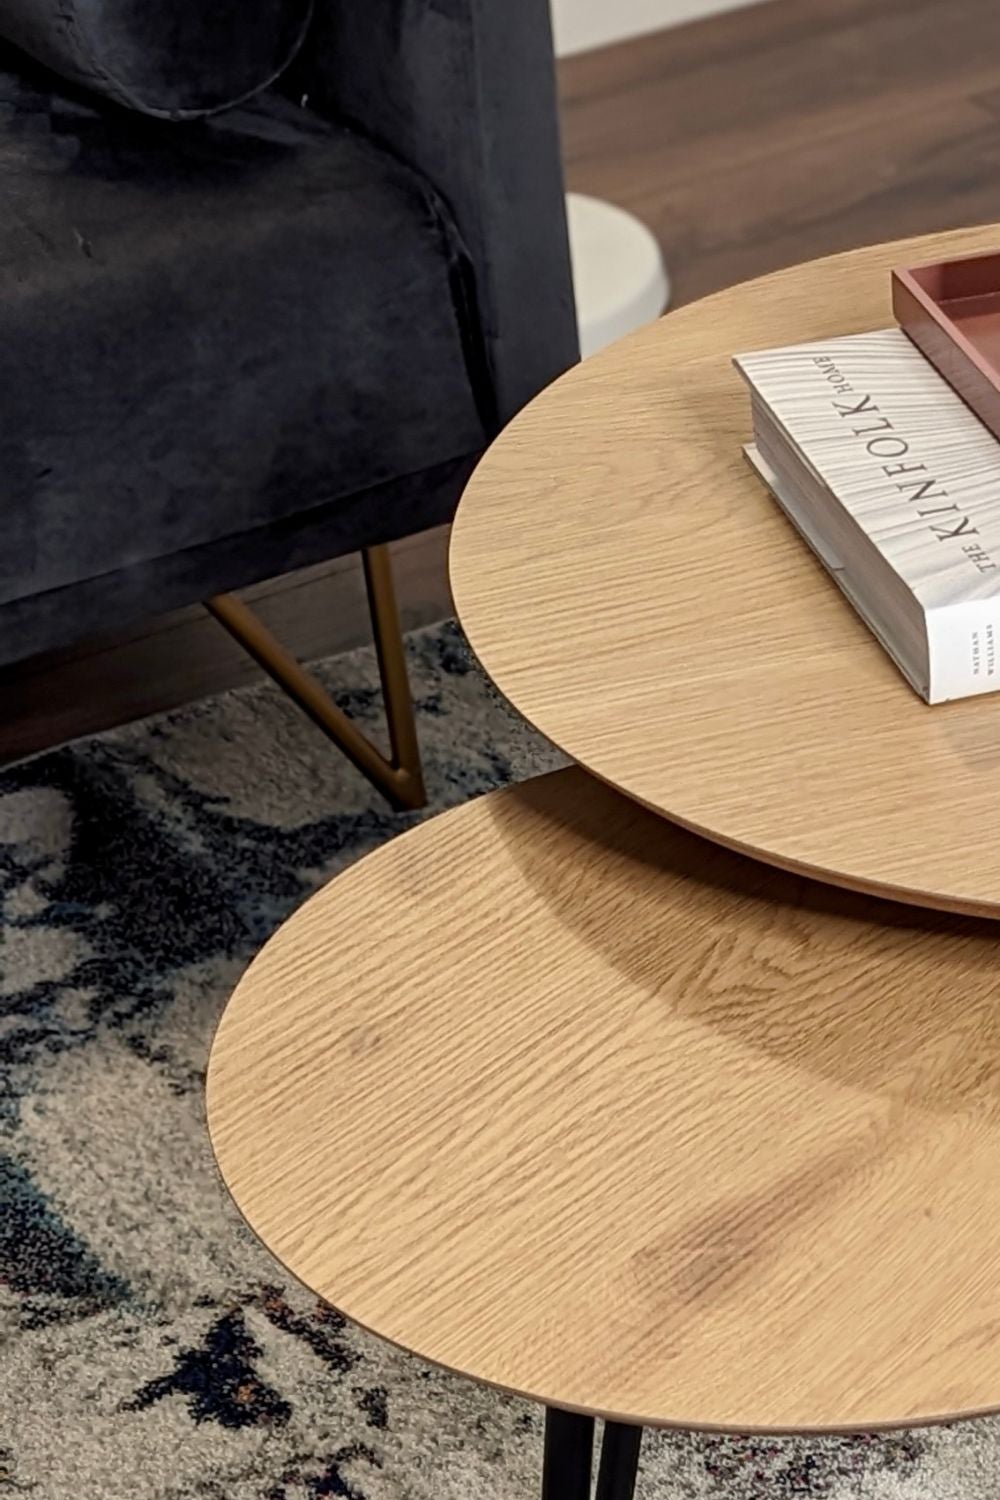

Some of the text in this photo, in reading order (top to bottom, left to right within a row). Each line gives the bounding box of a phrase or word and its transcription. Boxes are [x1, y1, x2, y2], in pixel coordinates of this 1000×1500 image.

[812, 355, 996, 573] THE KINFOLK HOME
